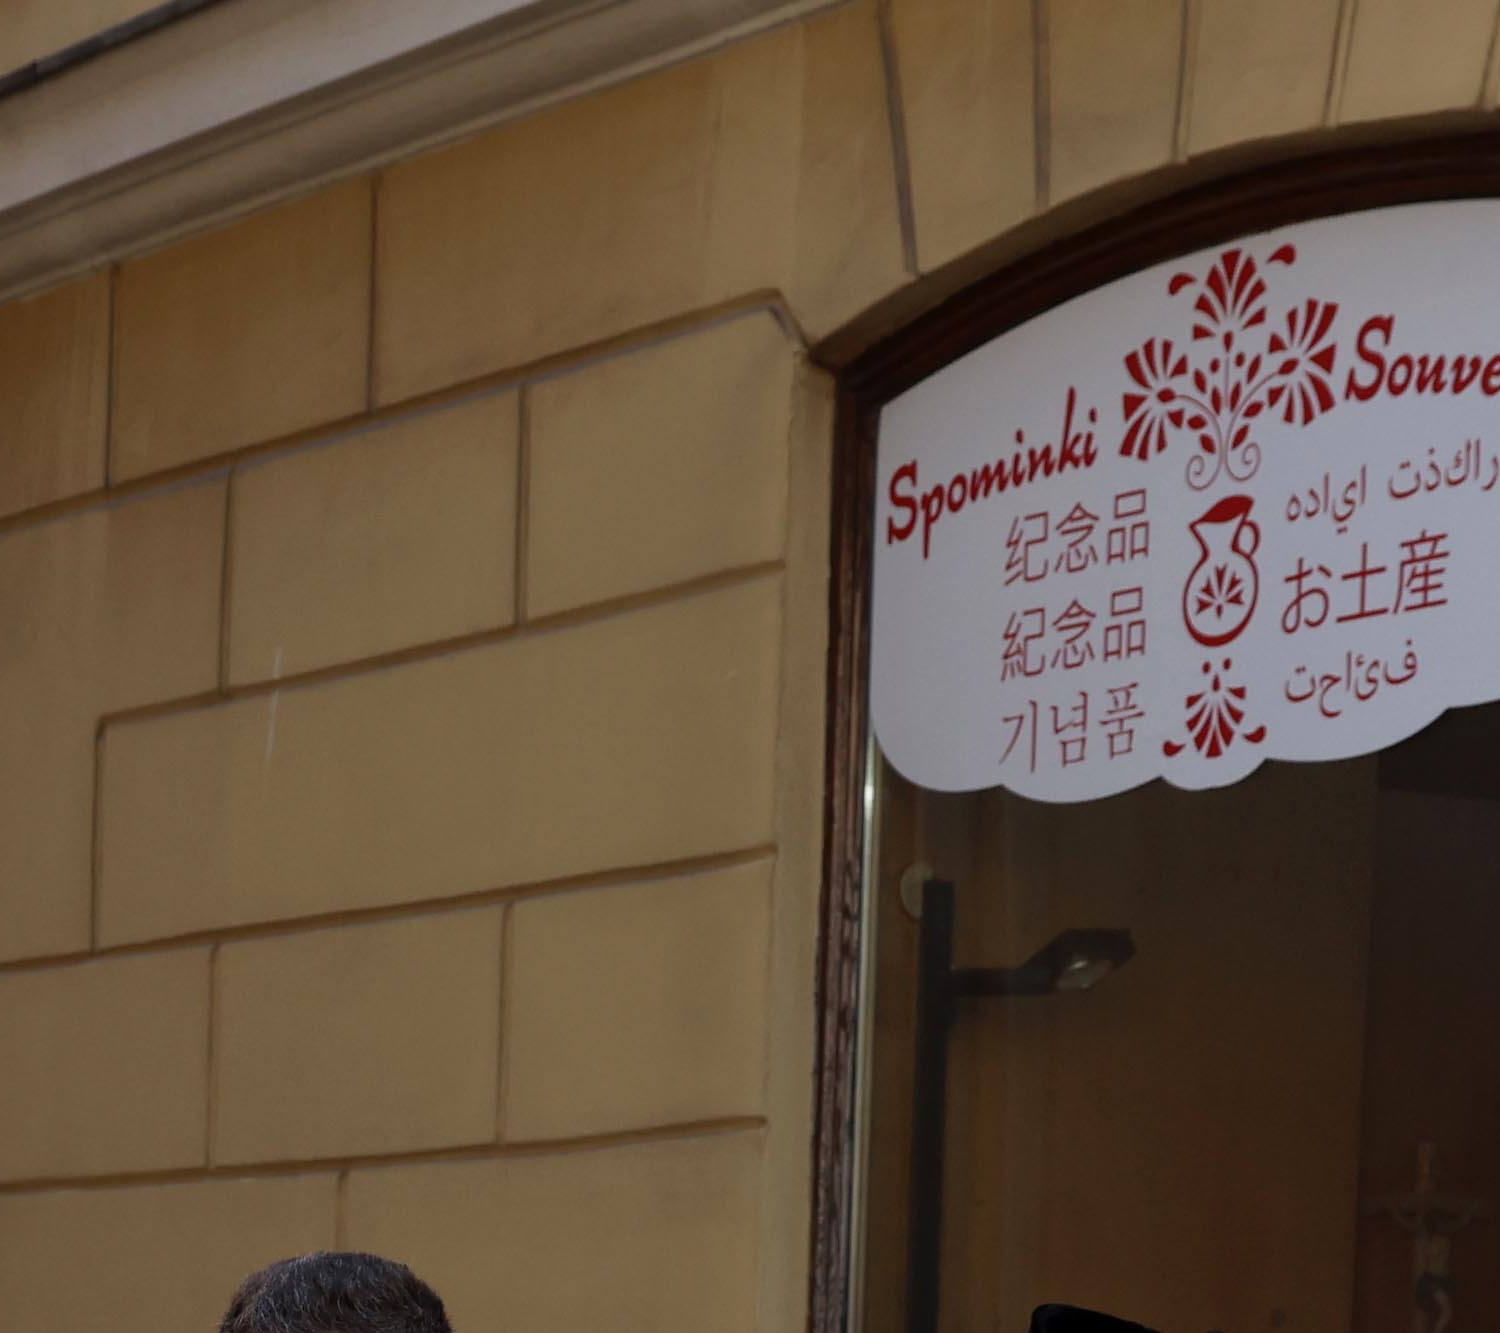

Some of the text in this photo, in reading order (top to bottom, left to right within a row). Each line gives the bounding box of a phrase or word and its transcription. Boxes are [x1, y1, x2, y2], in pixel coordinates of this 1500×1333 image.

[887, 387, 1098, 560] Spominki
[1004, 488, 1150, 586] 纪念品
[1281, 528, 1450, 634] お土産
[1001, 586, 1147, 682] 紀念品
[998, 682, 1146, 773] 기념품
